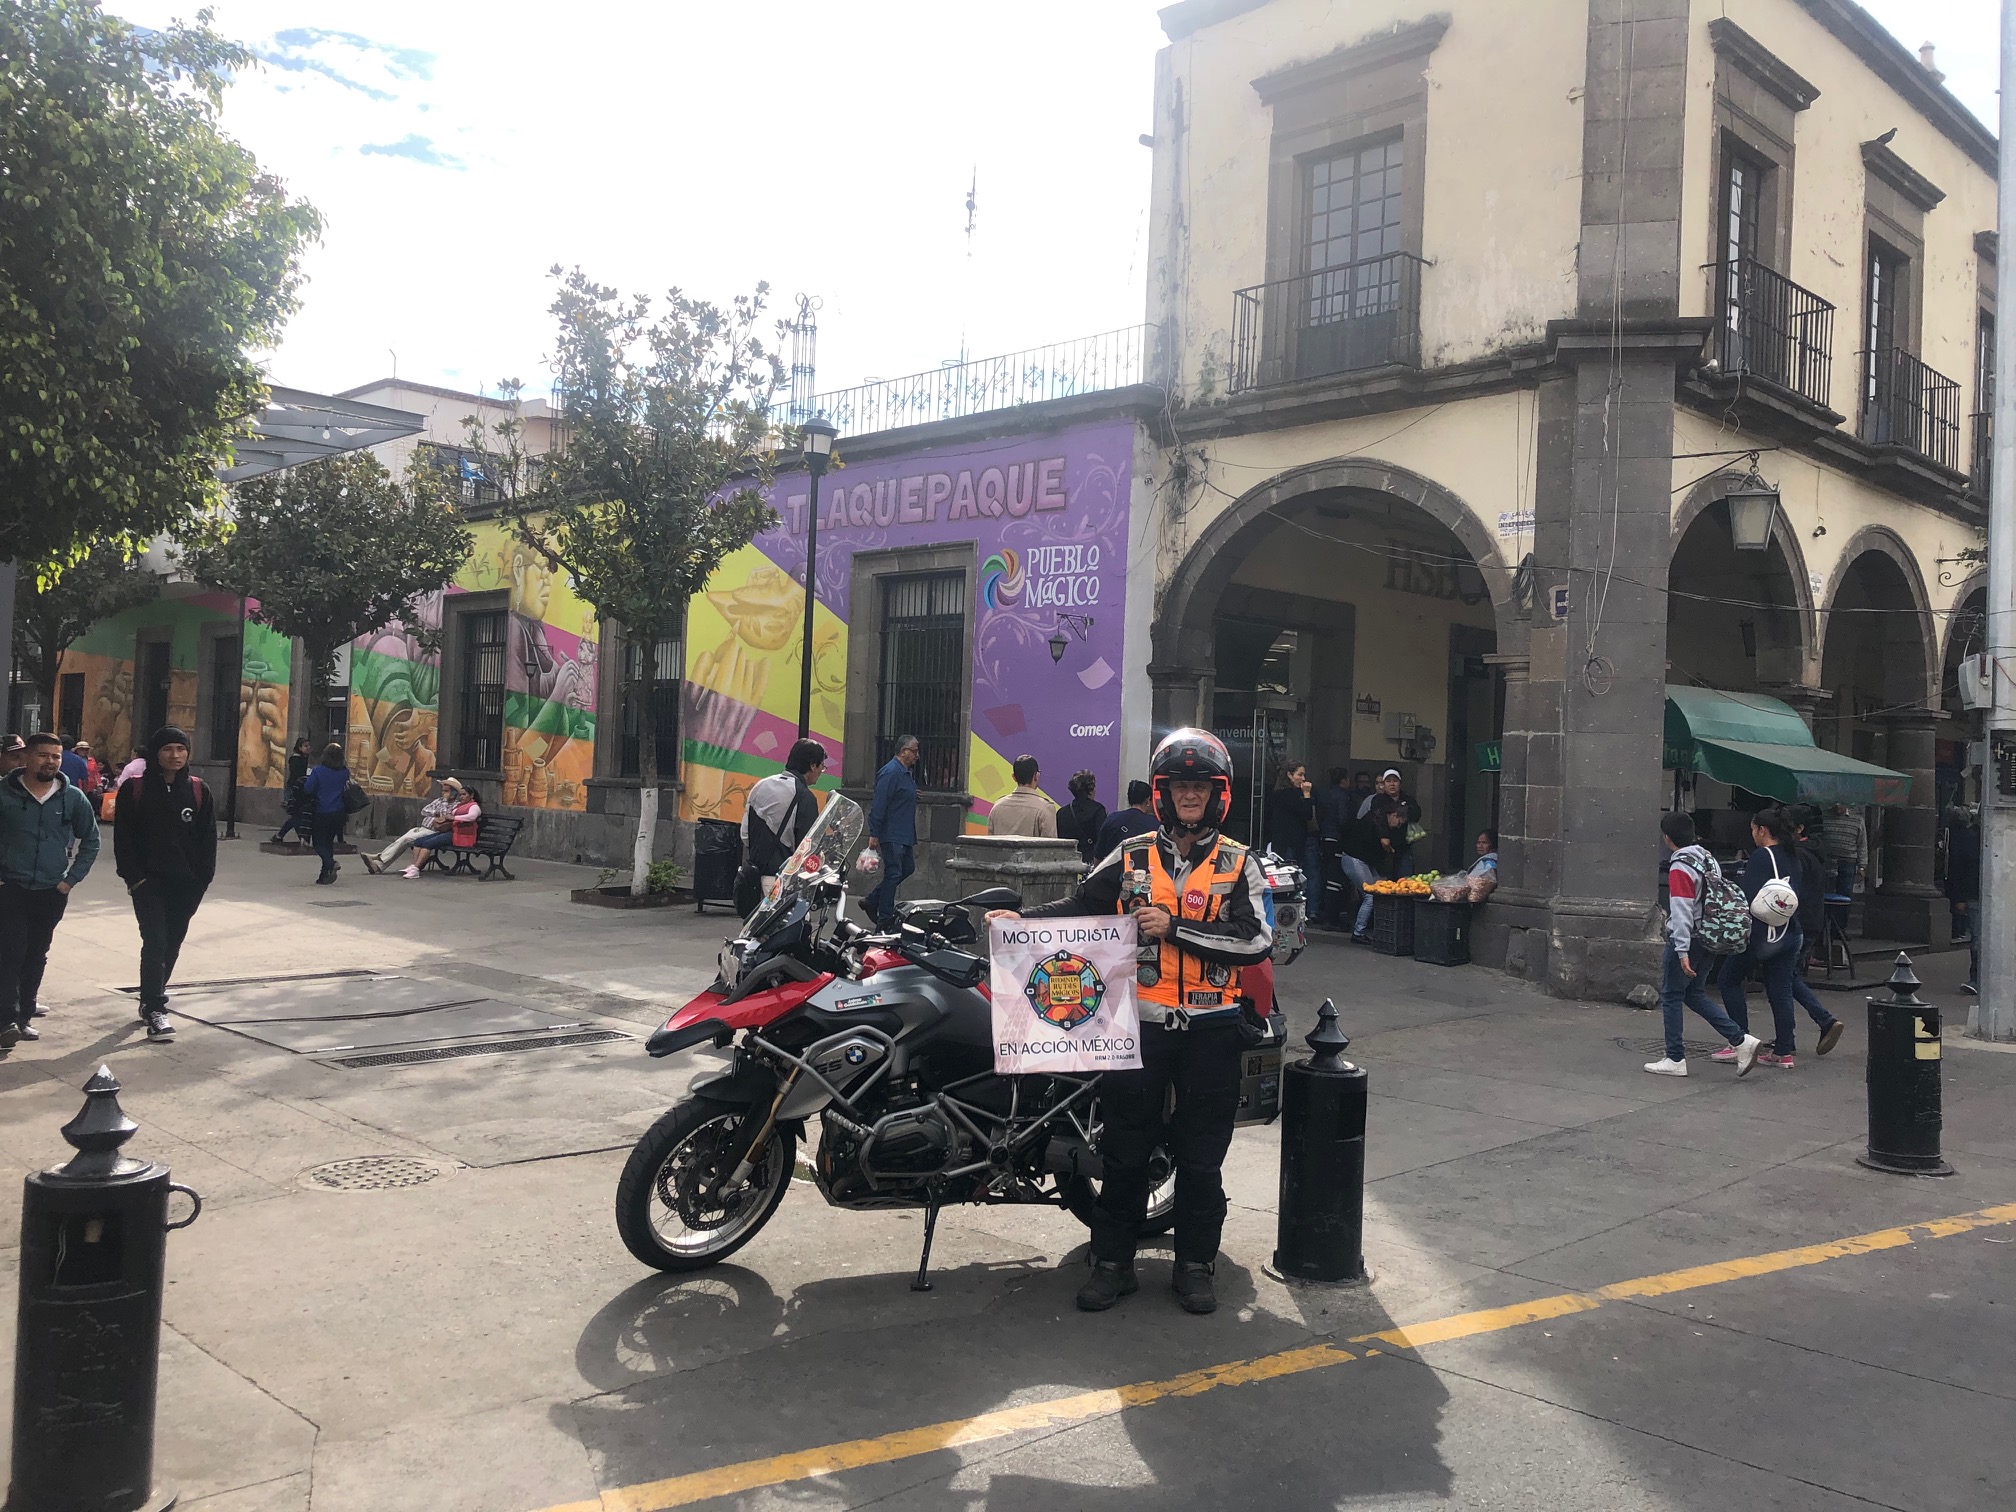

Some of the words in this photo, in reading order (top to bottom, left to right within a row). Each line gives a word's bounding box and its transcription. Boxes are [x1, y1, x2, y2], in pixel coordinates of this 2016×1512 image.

[1026, 544, 1100, 577] PUEBLO
[1069, 720, 1115, 737] Comex
[1187, 894, 1204, 905] 500
[1002, 930, 1053, 944] MOTO
[1056, 927, 1121, 943] TURISTA
[1191, 993, 1218, 1002] TERAPIA
[999, 1042, 1018, 1056] EN
[1021, 1036, 1078, 1054] ACCIÓN
[1082, 1035, 1135, 1052] MÉXICO
